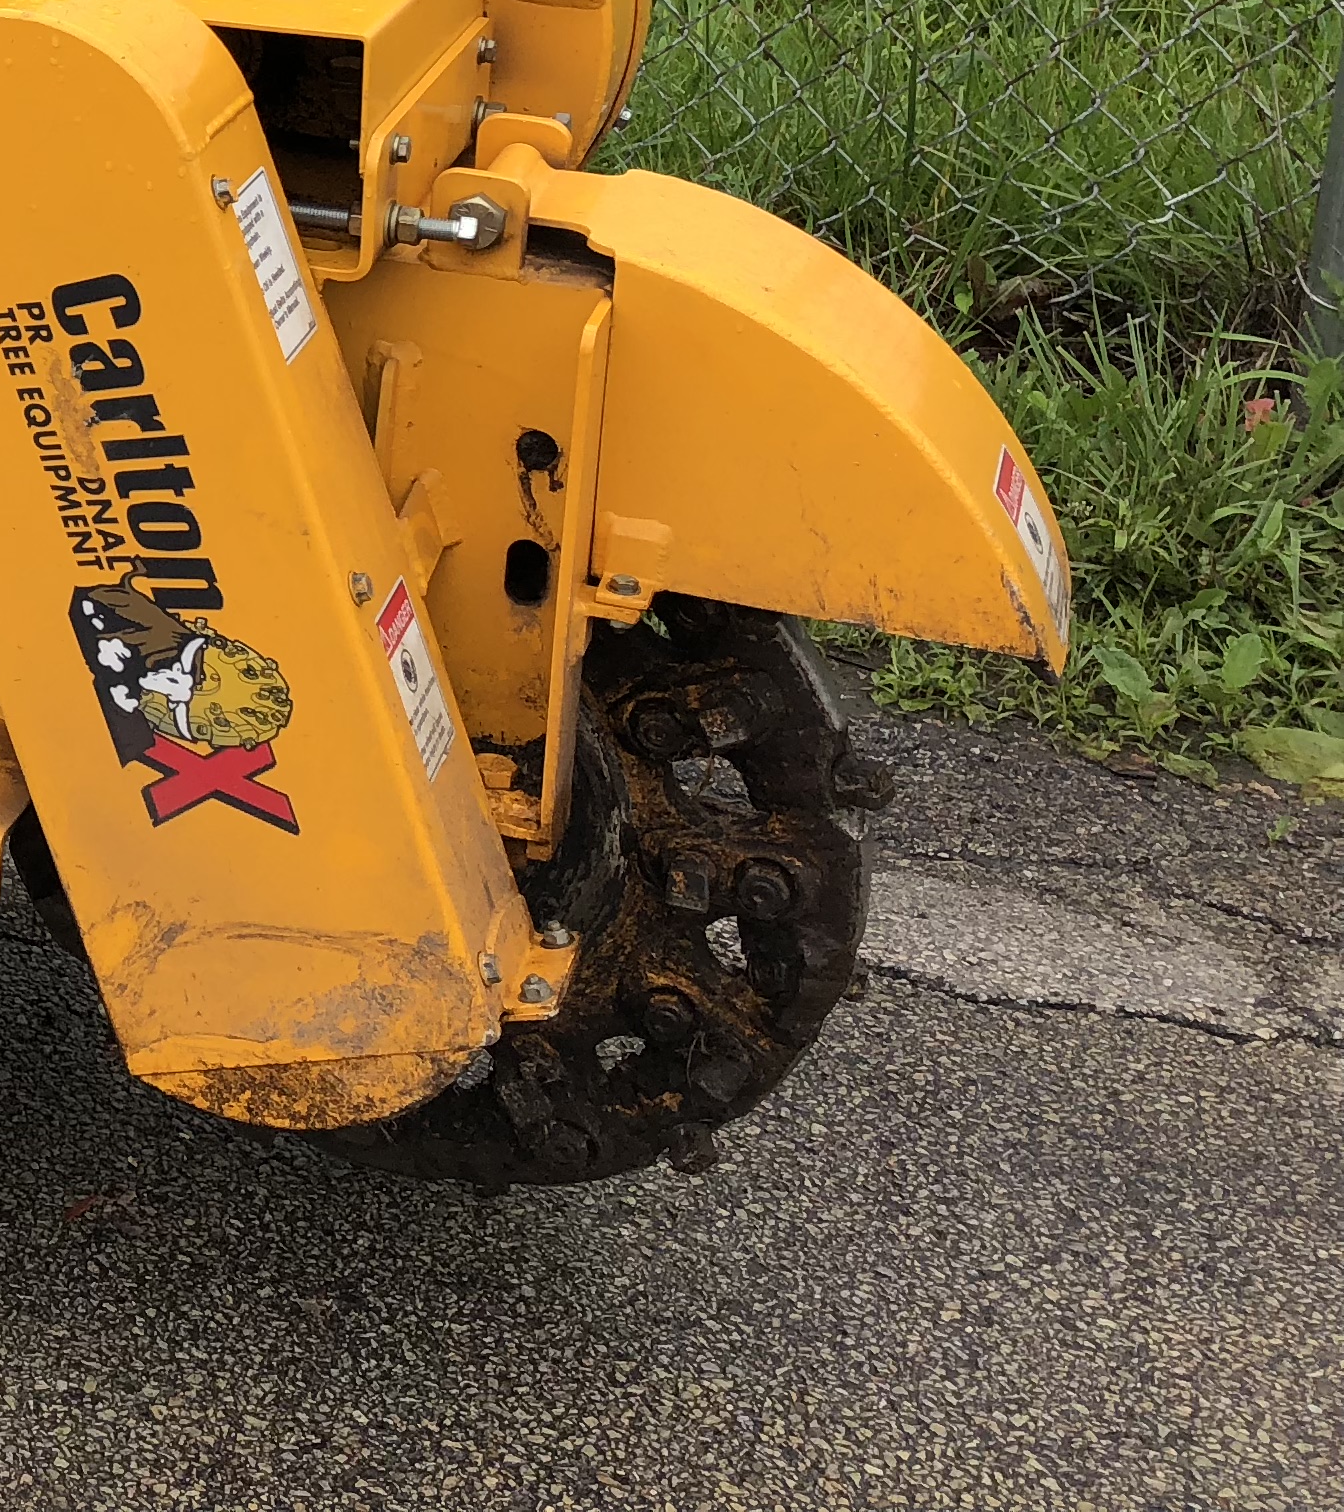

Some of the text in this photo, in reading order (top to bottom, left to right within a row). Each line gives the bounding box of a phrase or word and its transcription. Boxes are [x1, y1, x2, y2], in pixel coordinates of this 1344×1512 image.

[16, 387, 106, 571] EQUIPMENT
[52, 273, 224, 611] Carlton
[390, 598, 413, 645] DANGER
